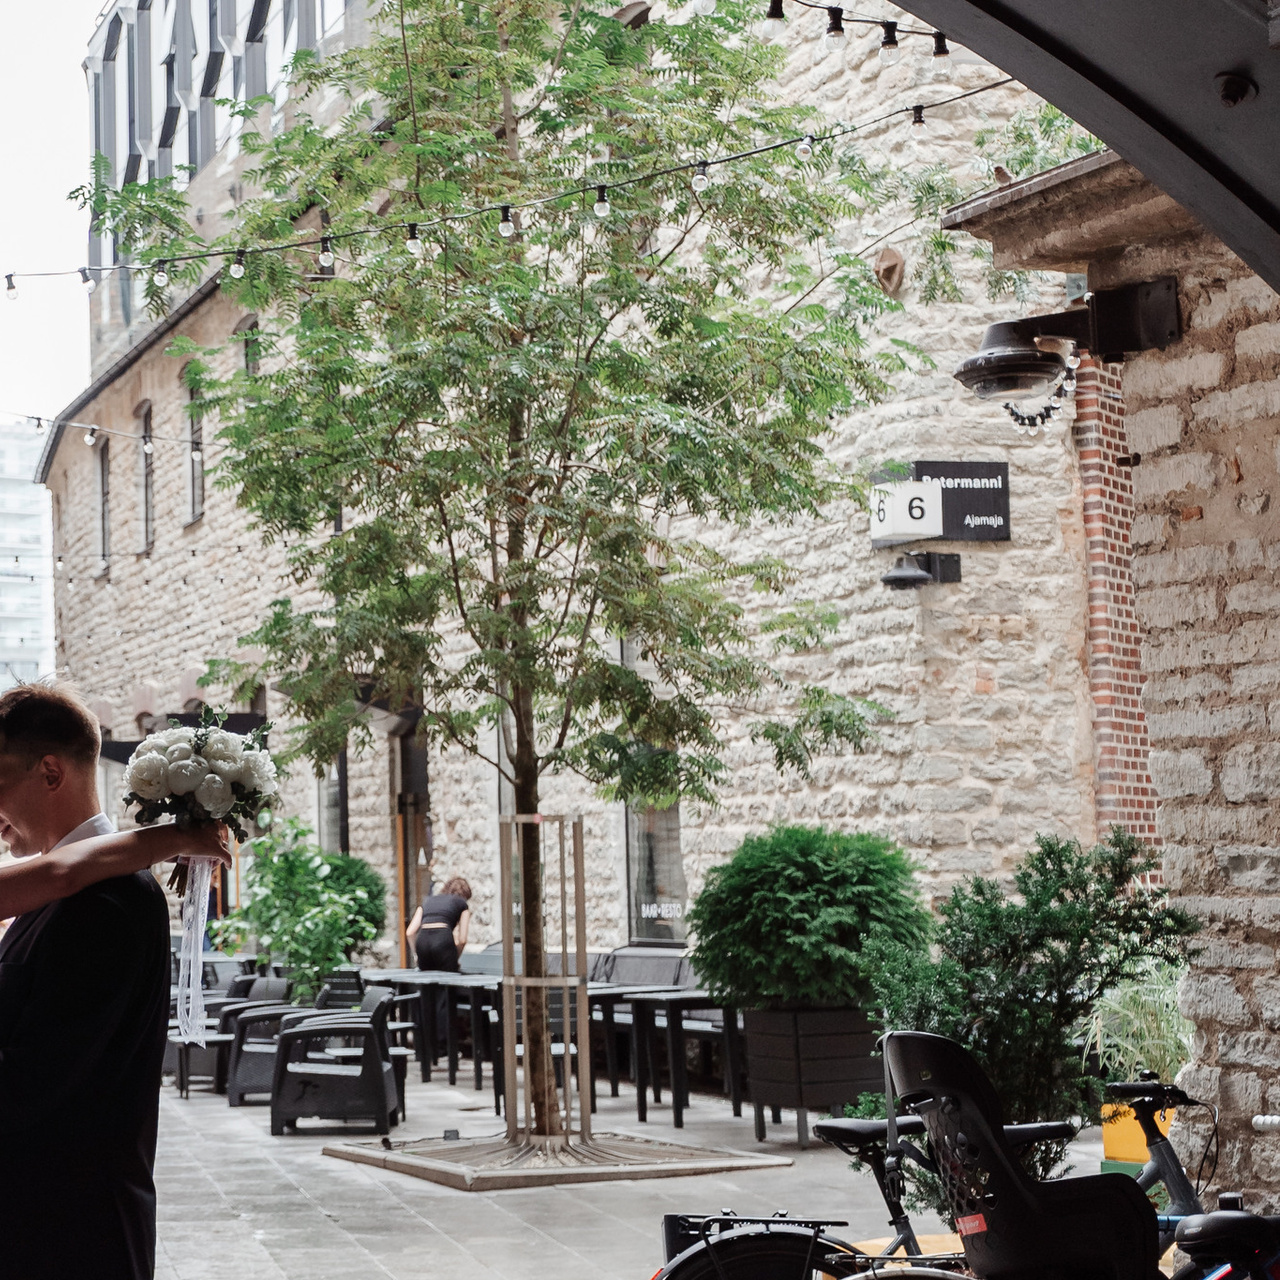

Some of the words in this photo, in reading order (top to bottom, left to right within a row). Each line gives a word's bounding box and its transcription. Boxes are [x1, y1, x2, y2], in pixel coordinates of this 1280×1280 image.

[877, 499, 886, 522] 6
[908, 497, 925, 520] 6
[964, 514, 1004, 529] Ajamaja
